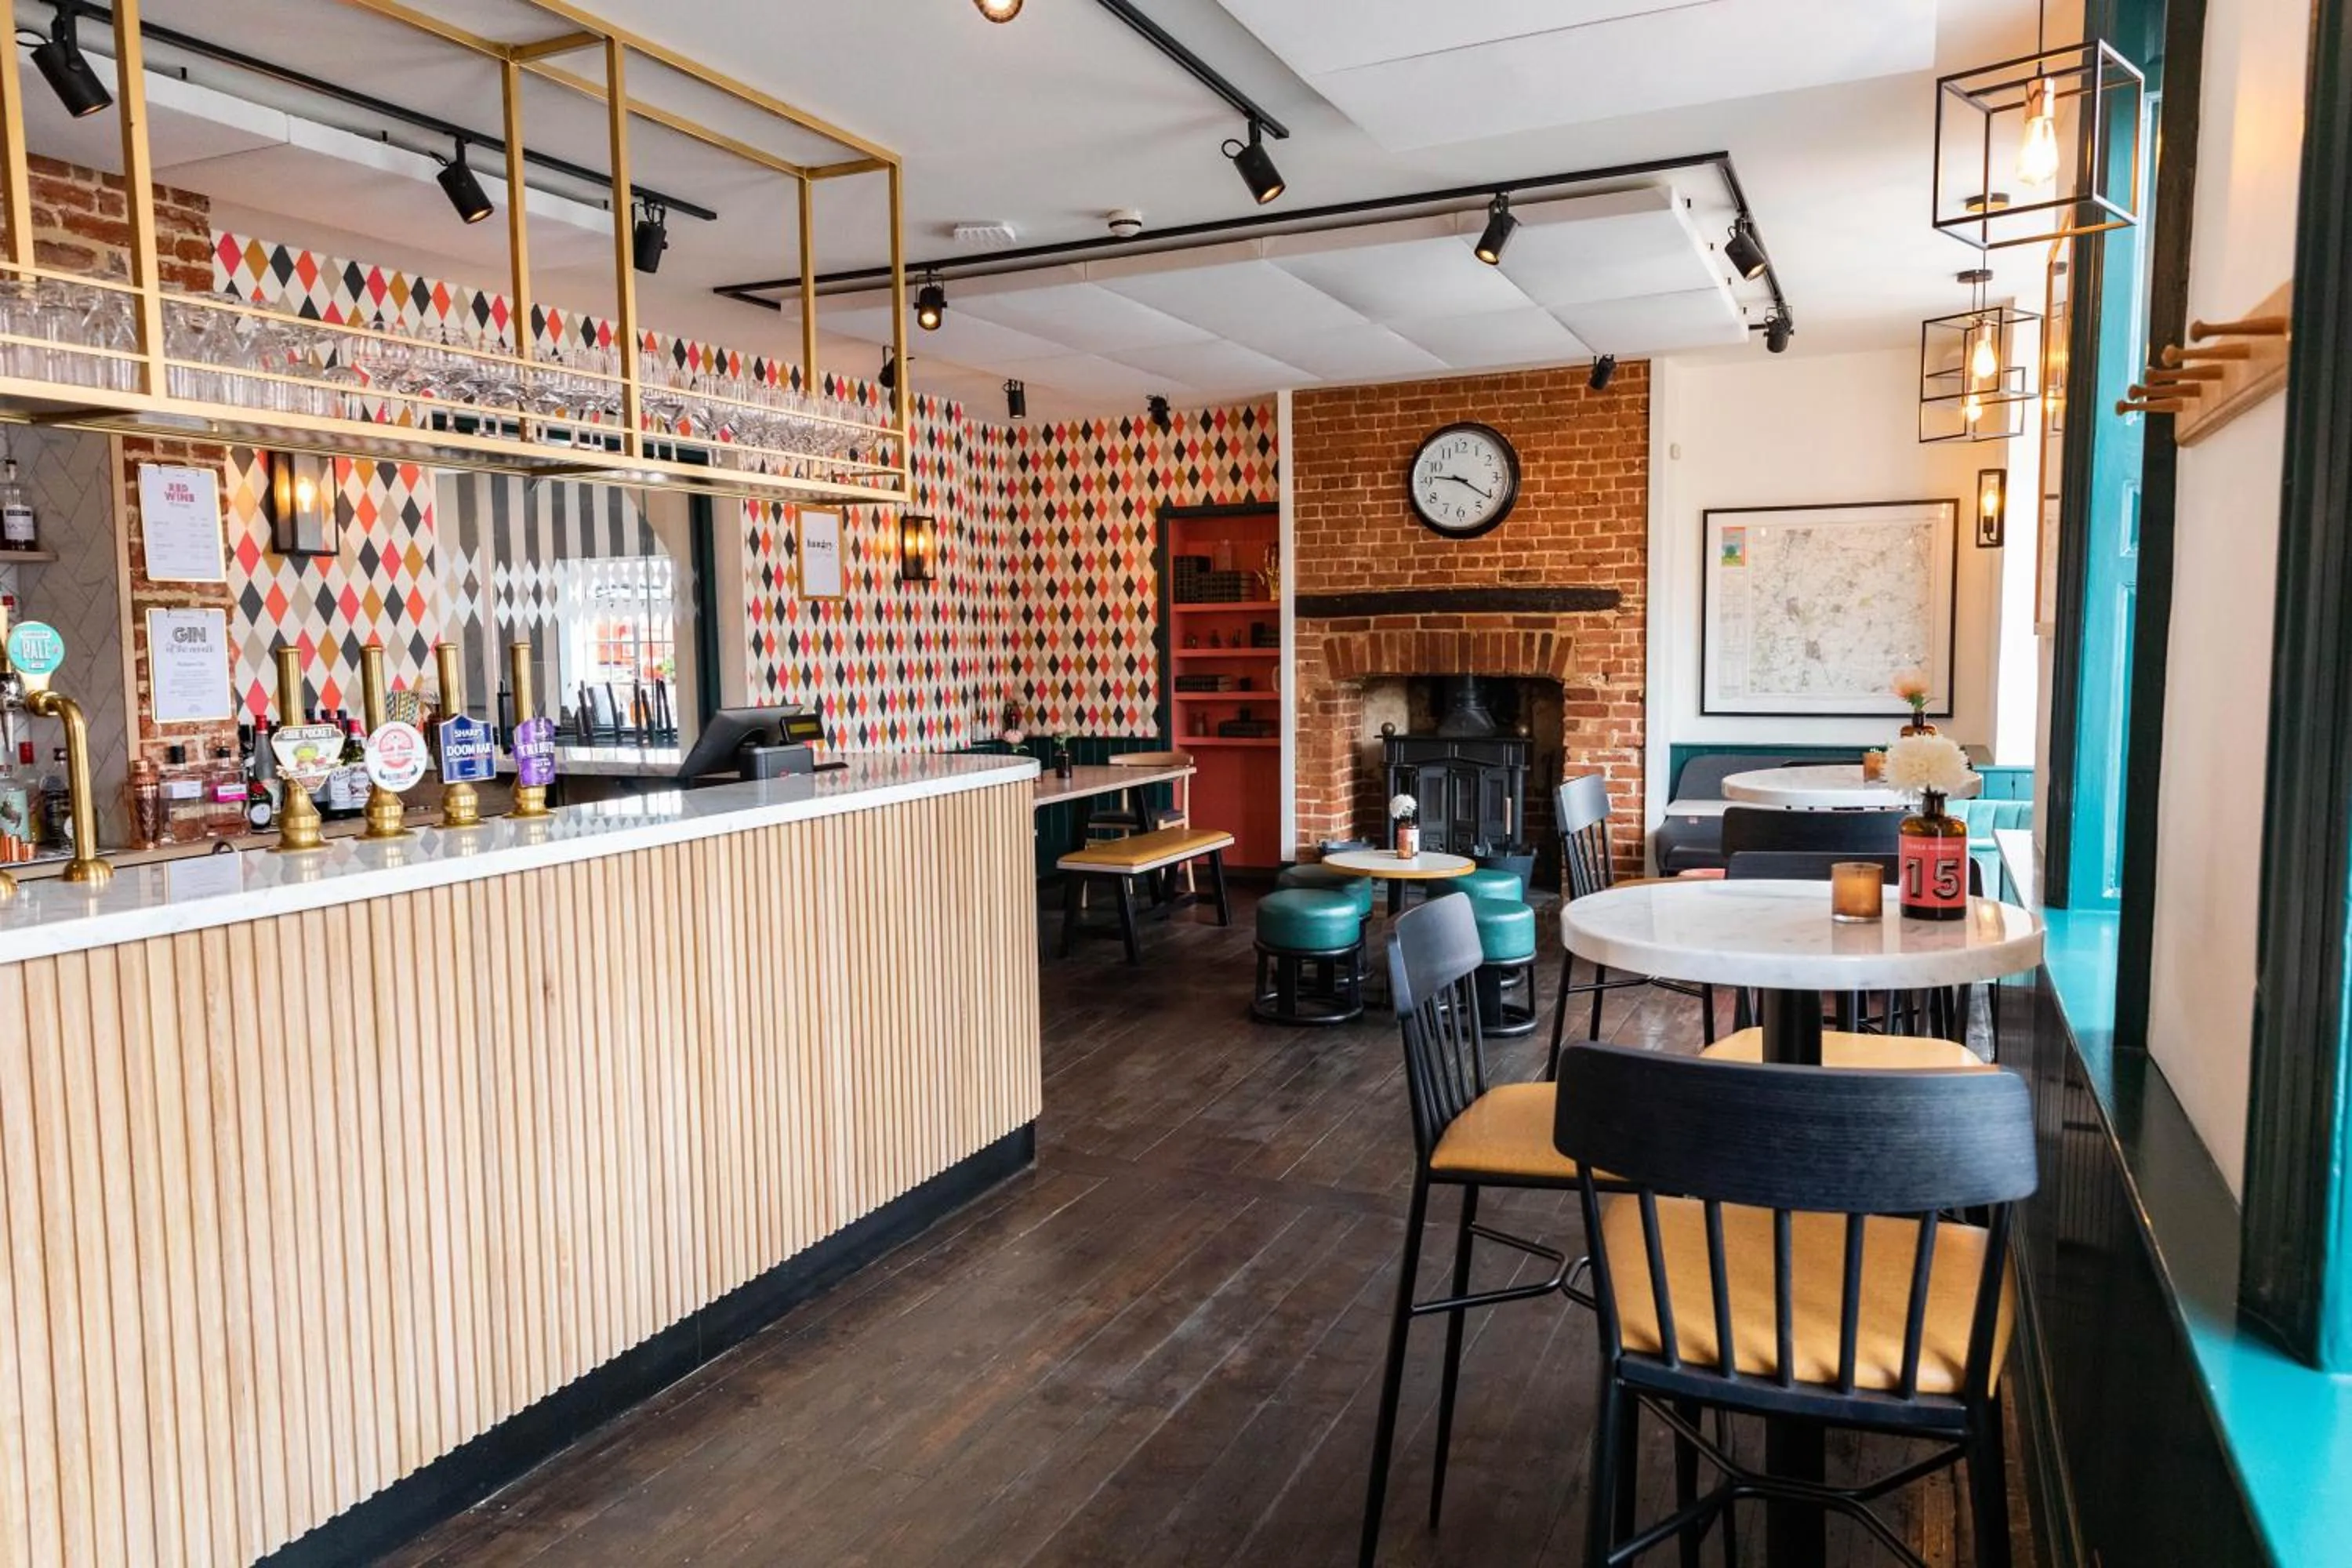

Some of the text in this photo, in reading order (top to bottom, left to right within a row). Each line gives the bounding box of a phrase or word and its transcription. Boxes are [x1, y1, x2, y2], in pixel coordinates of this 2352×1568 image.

[1441, 446, 1451, 460] 11
[1454, 441, 1468, 453] 12
[1474, 445, 1479, 456] 1
[1484, 454, 1492, 466] 2
[1429, 461, 1443, 473] 10
[1424, 477, 1433, 487] 9
[1492, 471, 1499, 484] 3
[164, 492, 195, 503] WINE
[1428, 492, 1438, 503] 8
[1442, 503, 1450, 514] 7
[1456, 505, 1465, 517] 6
[1475, 500, 1483, 515] 5
[172, 626, 207, 643] GIN
[22, 638, 51, 660] PALE
[302, 727, 332, 739] POCKET
[445, 743, 475, 757] DOOM
[1906, 856, 1961, 900] 15
